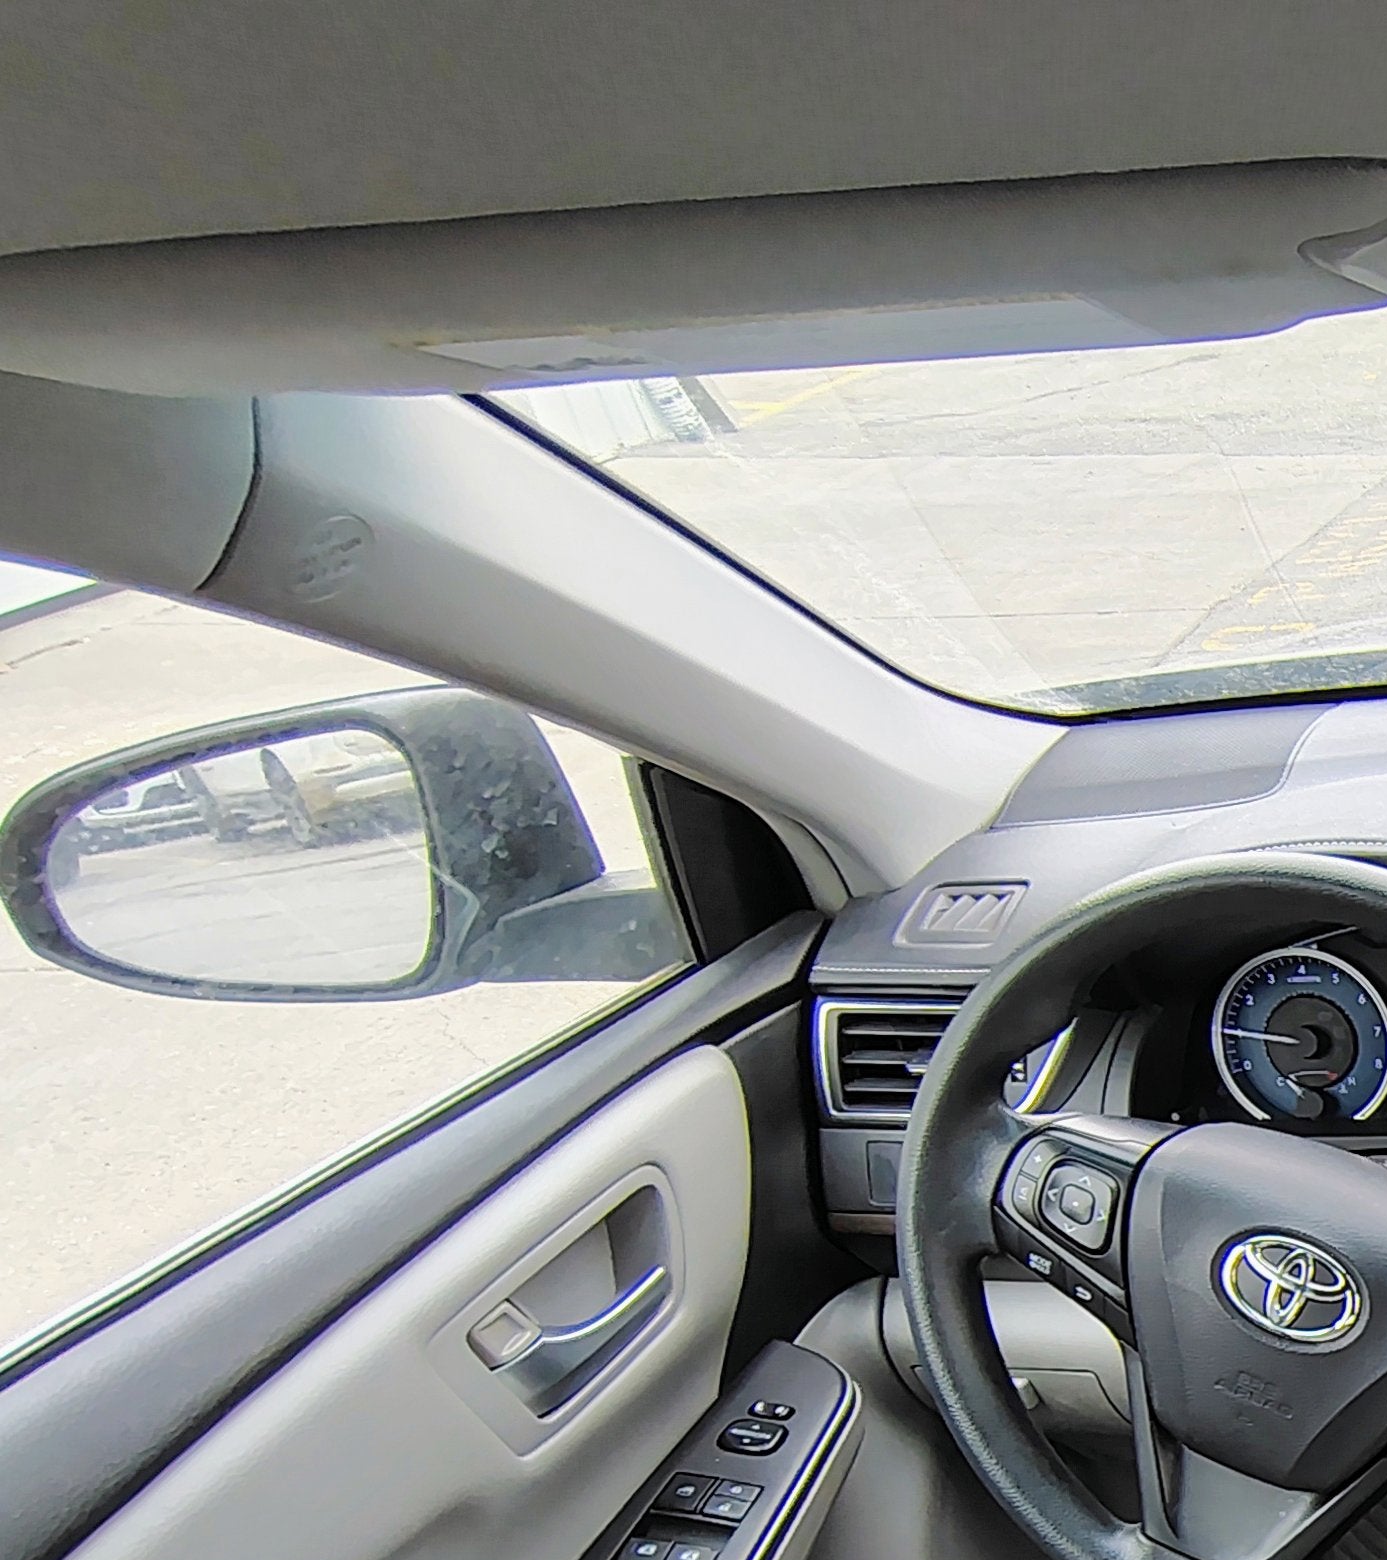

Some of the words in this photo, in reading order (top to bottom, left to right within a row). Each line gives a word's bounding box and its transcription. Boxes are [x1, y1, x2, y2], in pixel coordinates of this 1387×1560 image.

[1297, 965, 1306, 975] 4
[1267, 973, 1276, 985] 3
[1331, 973, 1340, 985] 5
[1245, 994, 1254, 1006] 2
[1358, 994, 1367, 1004] 6
[1373, 1026, 1381, 1037] 7
[1243, 1060, 1251, 1071] 0
